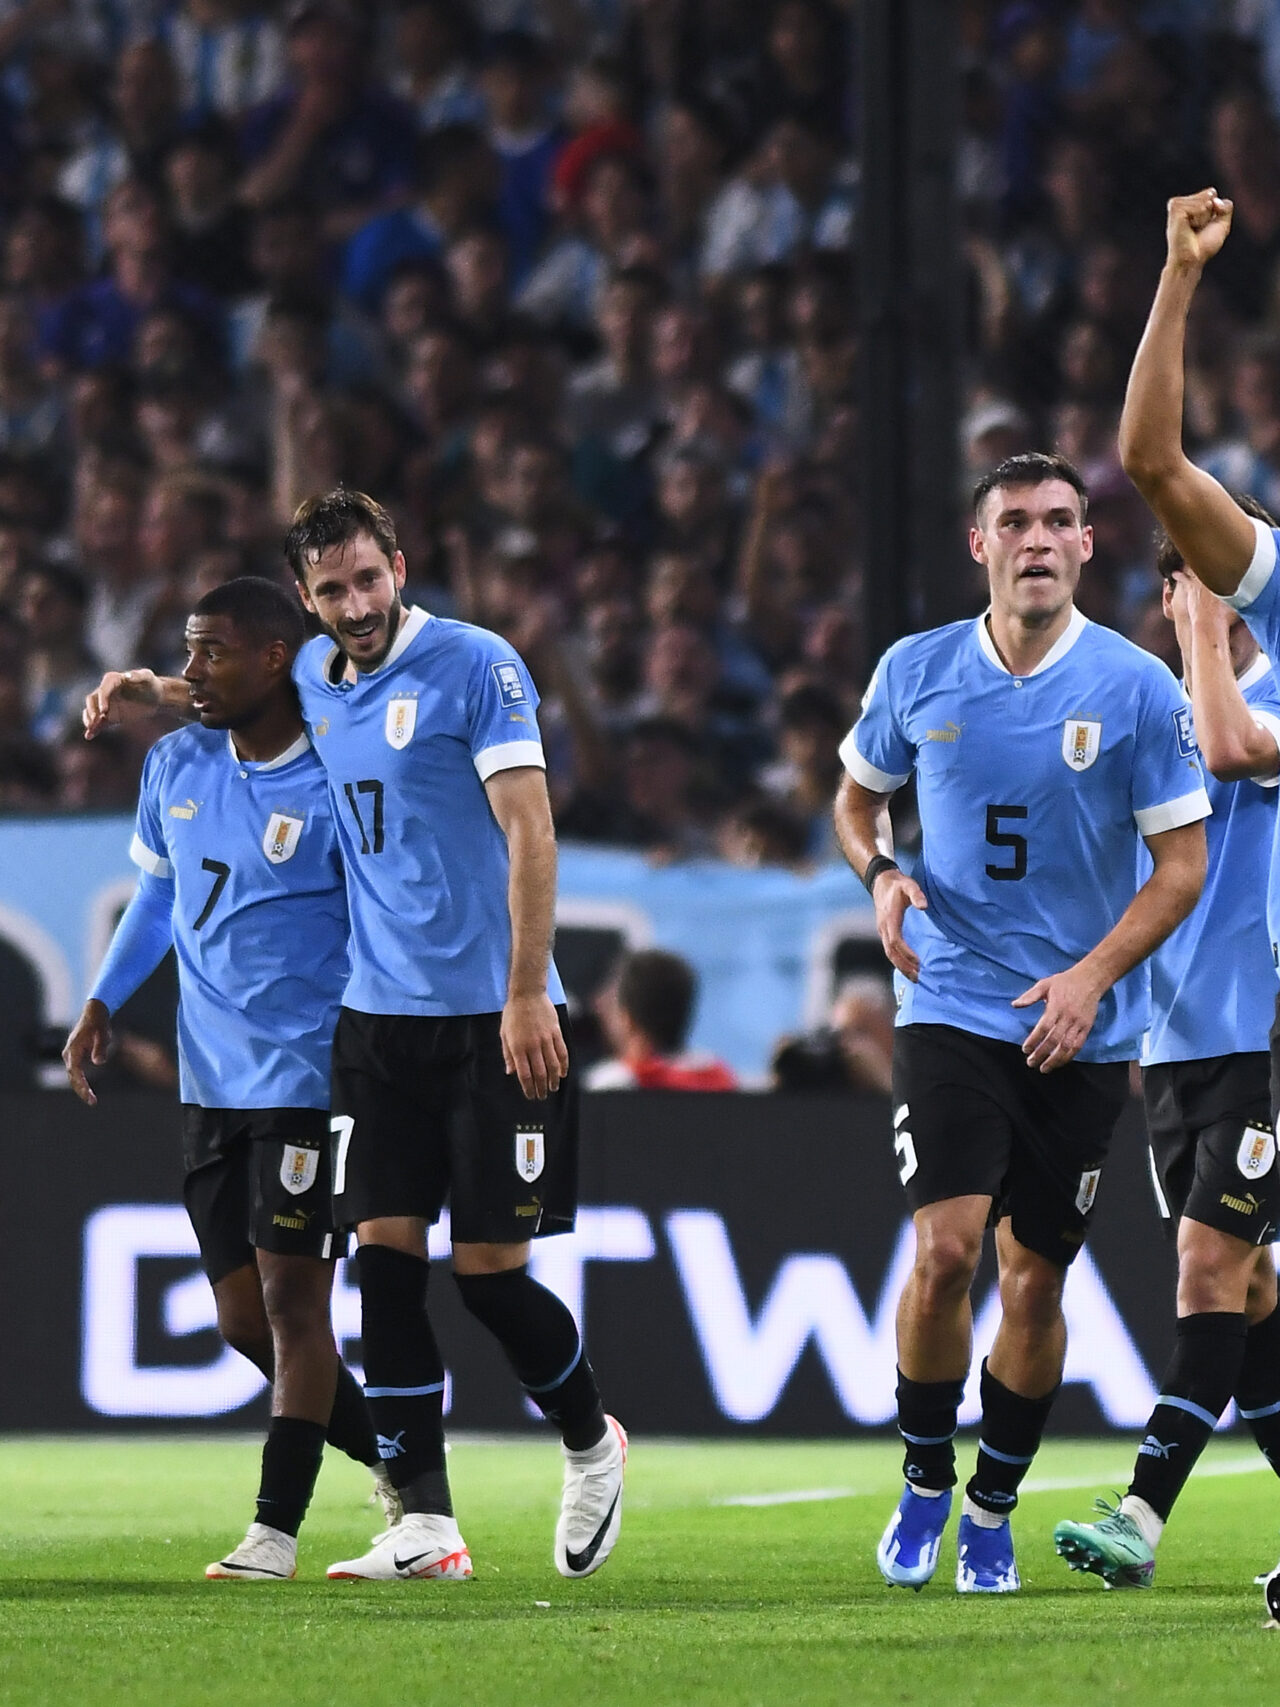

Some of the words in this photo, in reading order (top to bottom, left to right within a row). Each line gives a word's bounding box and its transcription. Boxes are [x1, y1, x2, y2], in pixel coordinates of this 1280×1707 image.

[343, 779, 385, 855] 17
[985, 804, 1028, 881] 5
[193, 857, 231, 931] 7
[272, 1214, 305, 1231] PUMA
[1220, 1193, 1254, 1216] PUMA
